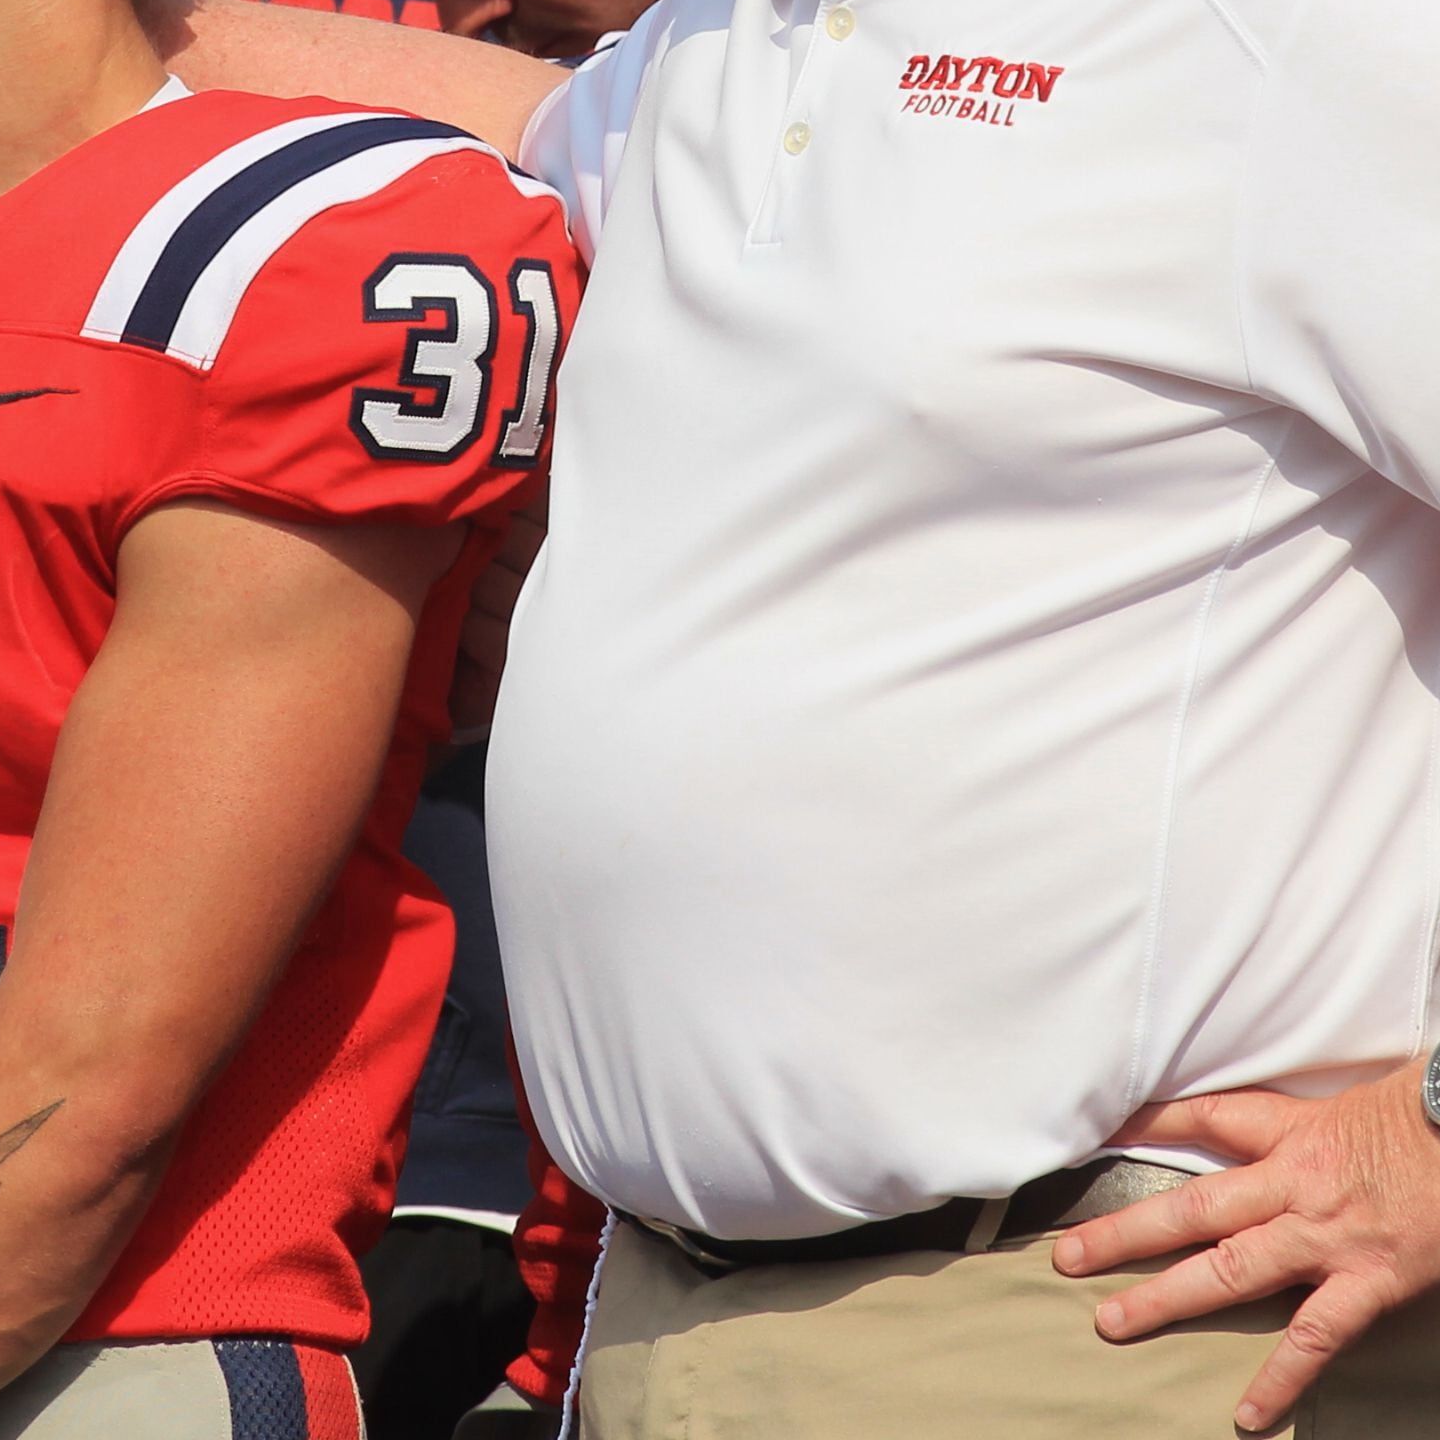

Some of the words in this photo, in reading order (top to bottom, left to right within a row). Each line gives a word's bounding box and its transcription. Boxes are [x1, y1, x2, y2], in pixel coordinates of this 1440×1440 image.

[898, 54, 1065, 104] DAYTON
[899, 94, 1015, 126] FOOTBALL
[348, 251, 564, 469] 31
